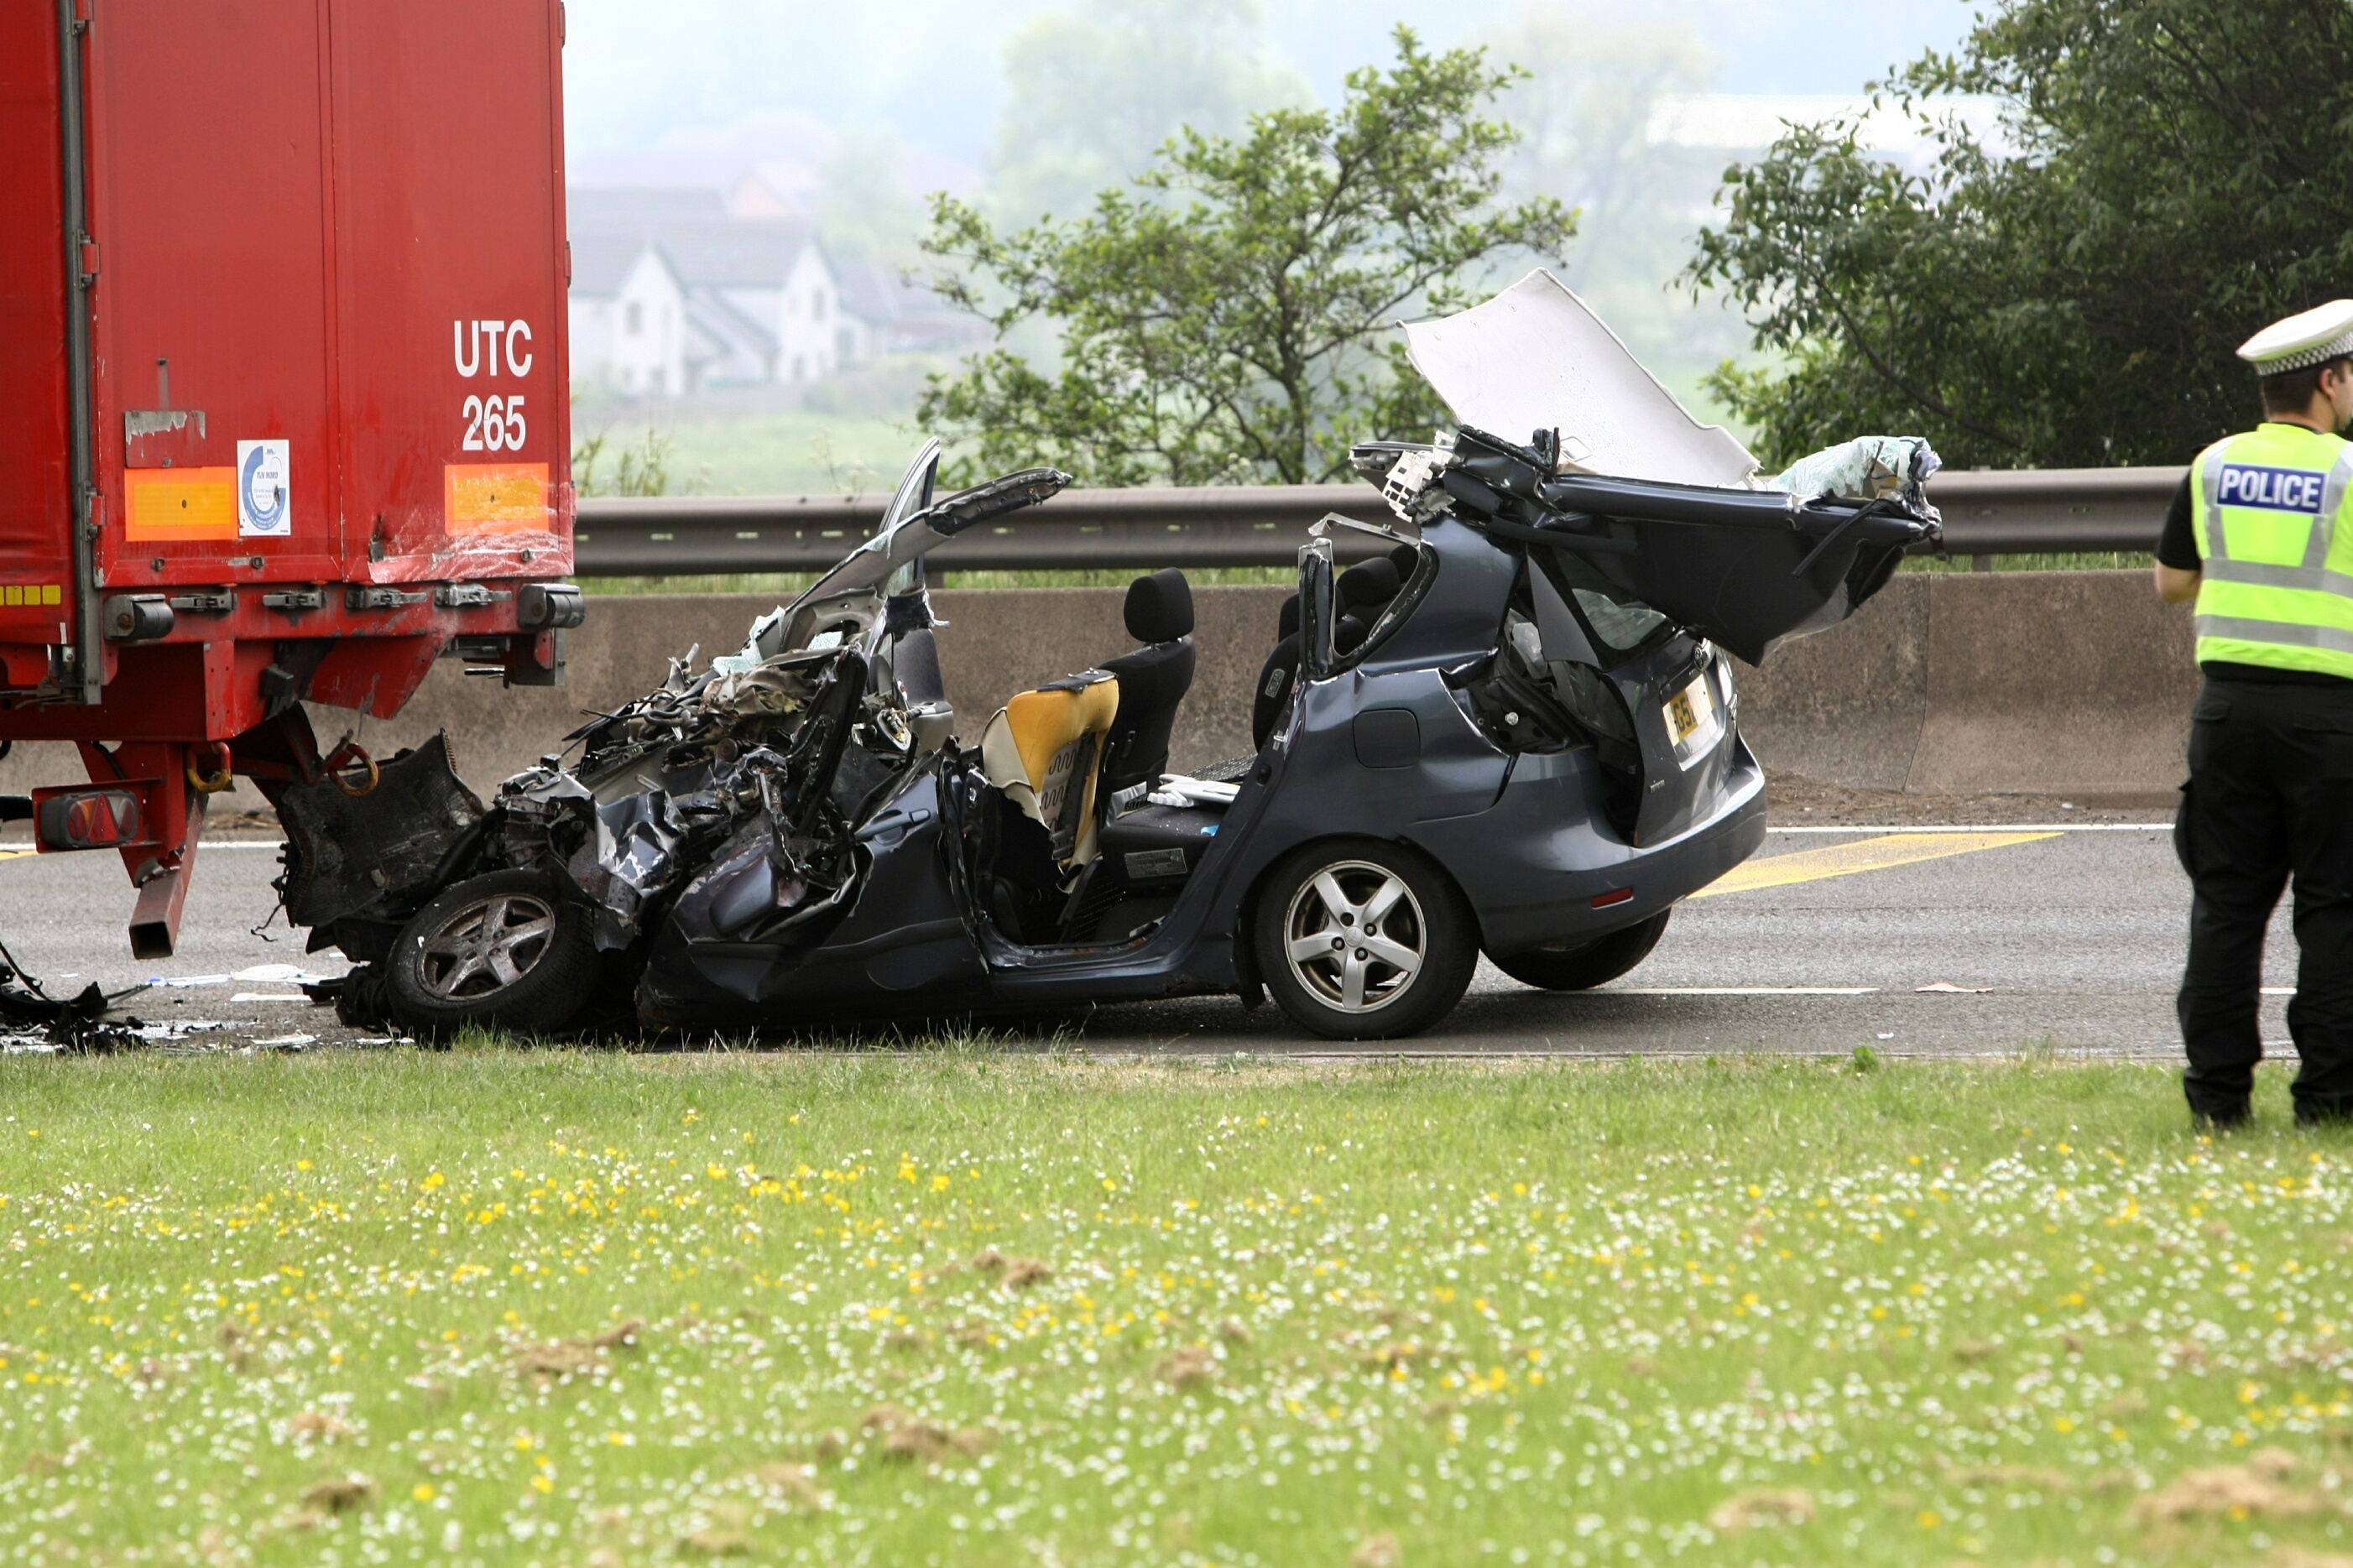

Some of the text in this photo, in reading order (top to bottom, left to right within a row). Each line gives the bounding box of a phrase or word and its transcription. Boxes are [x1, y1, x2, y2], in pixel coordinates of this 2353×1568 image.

[454, 319, 532, 378] UTC
[462, 394, 526, 451] 265
[2220, 468, 2321, 508] POLICE
[1672, 695, 1696, 733] G5
